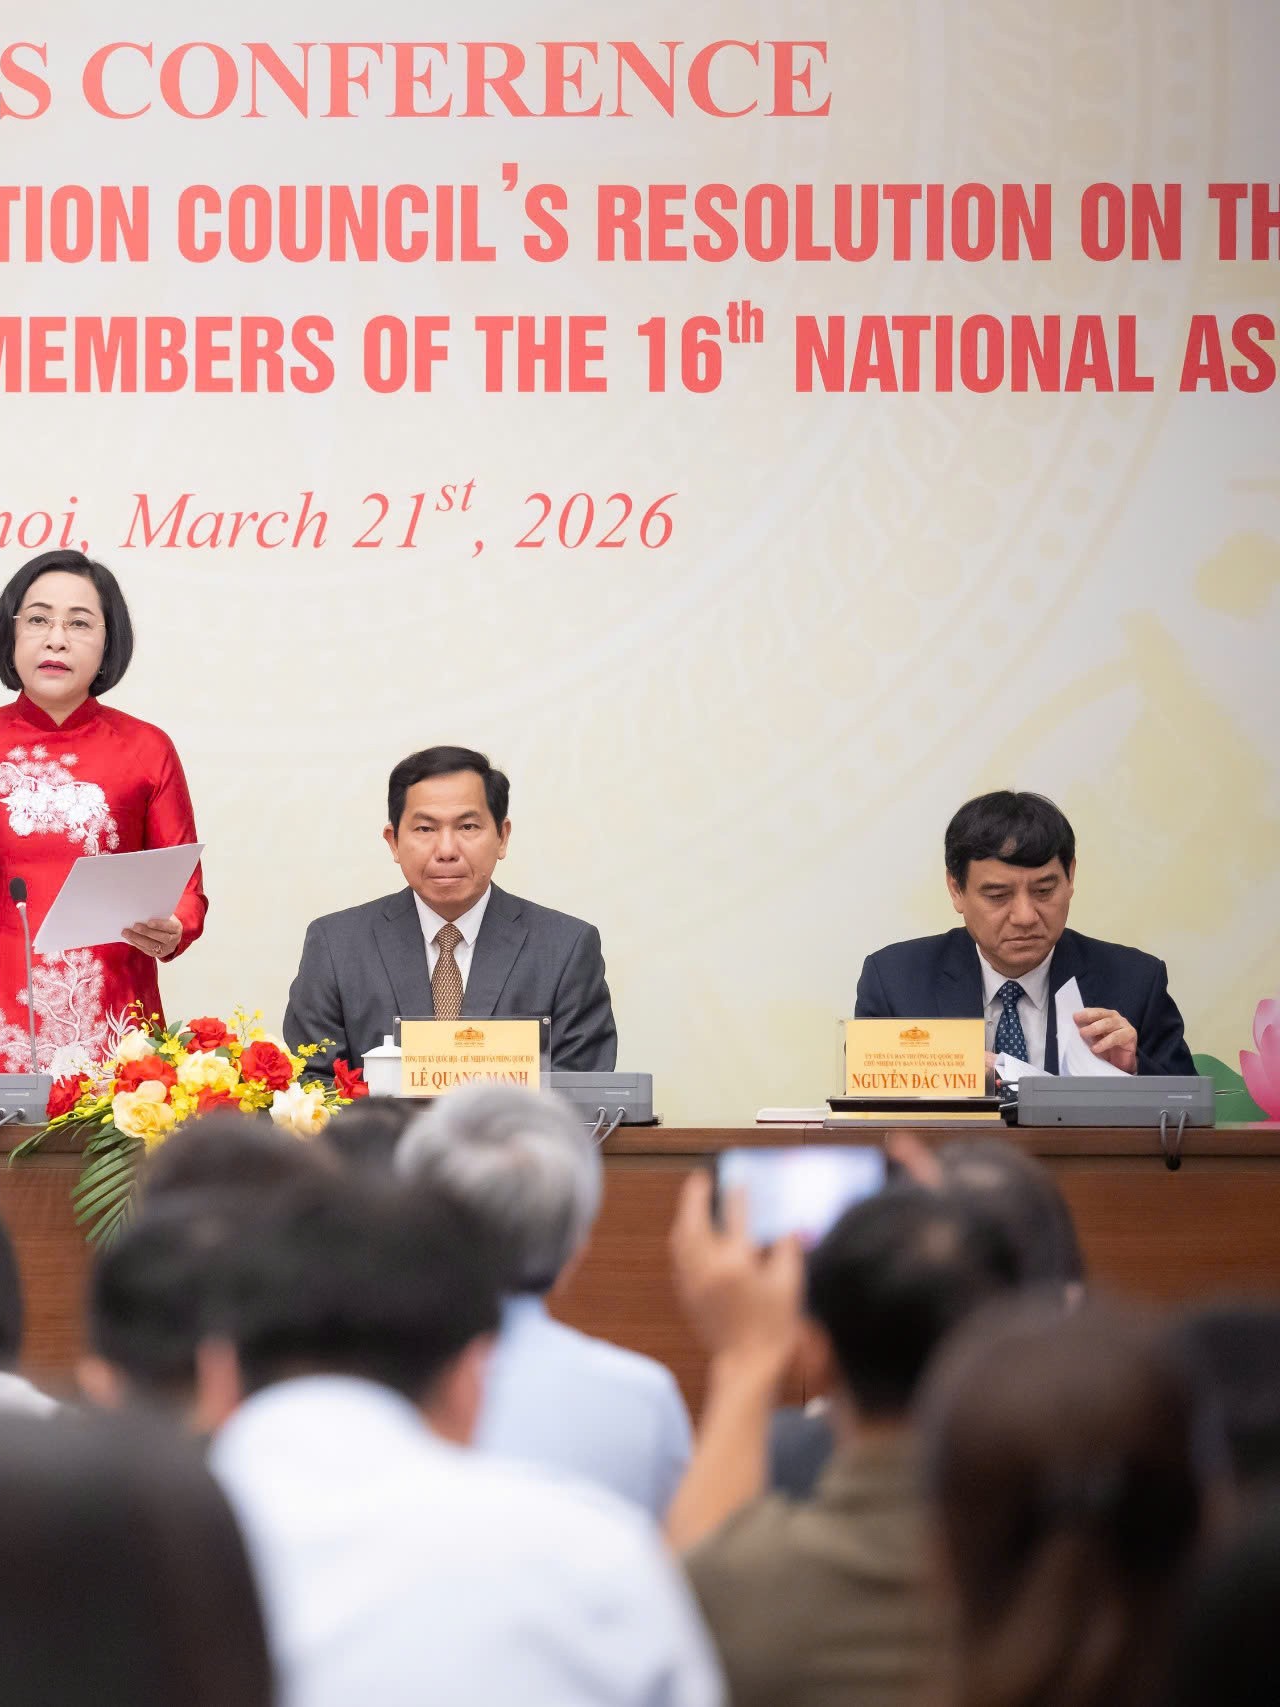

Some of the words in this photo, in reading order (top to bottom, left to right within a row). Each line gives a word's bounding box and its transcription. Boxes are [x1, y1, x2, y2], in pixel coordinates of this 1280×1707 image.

[81, 40, 832, 120] CONFERENCE
[597, 182, 1052, 263] RESOLUTION
[1081, 182, 1182, 262] ON
[364, 315, 450, 394] OF
[475, 315, 607, 392] THE
[638, 300, 764, 394] 16th
[795, 313, 1154, 393] NATIONAL
[1179, 314, 1276, 393] AS
[119, 491, 328, 549] March
[352, 480, 484, 557] 21st,
[515, 492, 675, 549] 2026
[411, 1067, 428, 1086] LÊ
[432, 1072, 481, 1089] QUANG
[852, 1069, 908, 1088] NGUYỄN
[912, 1069, 939, 1088] ĐẮC
[944, 1074, 976, 1088] VINH
